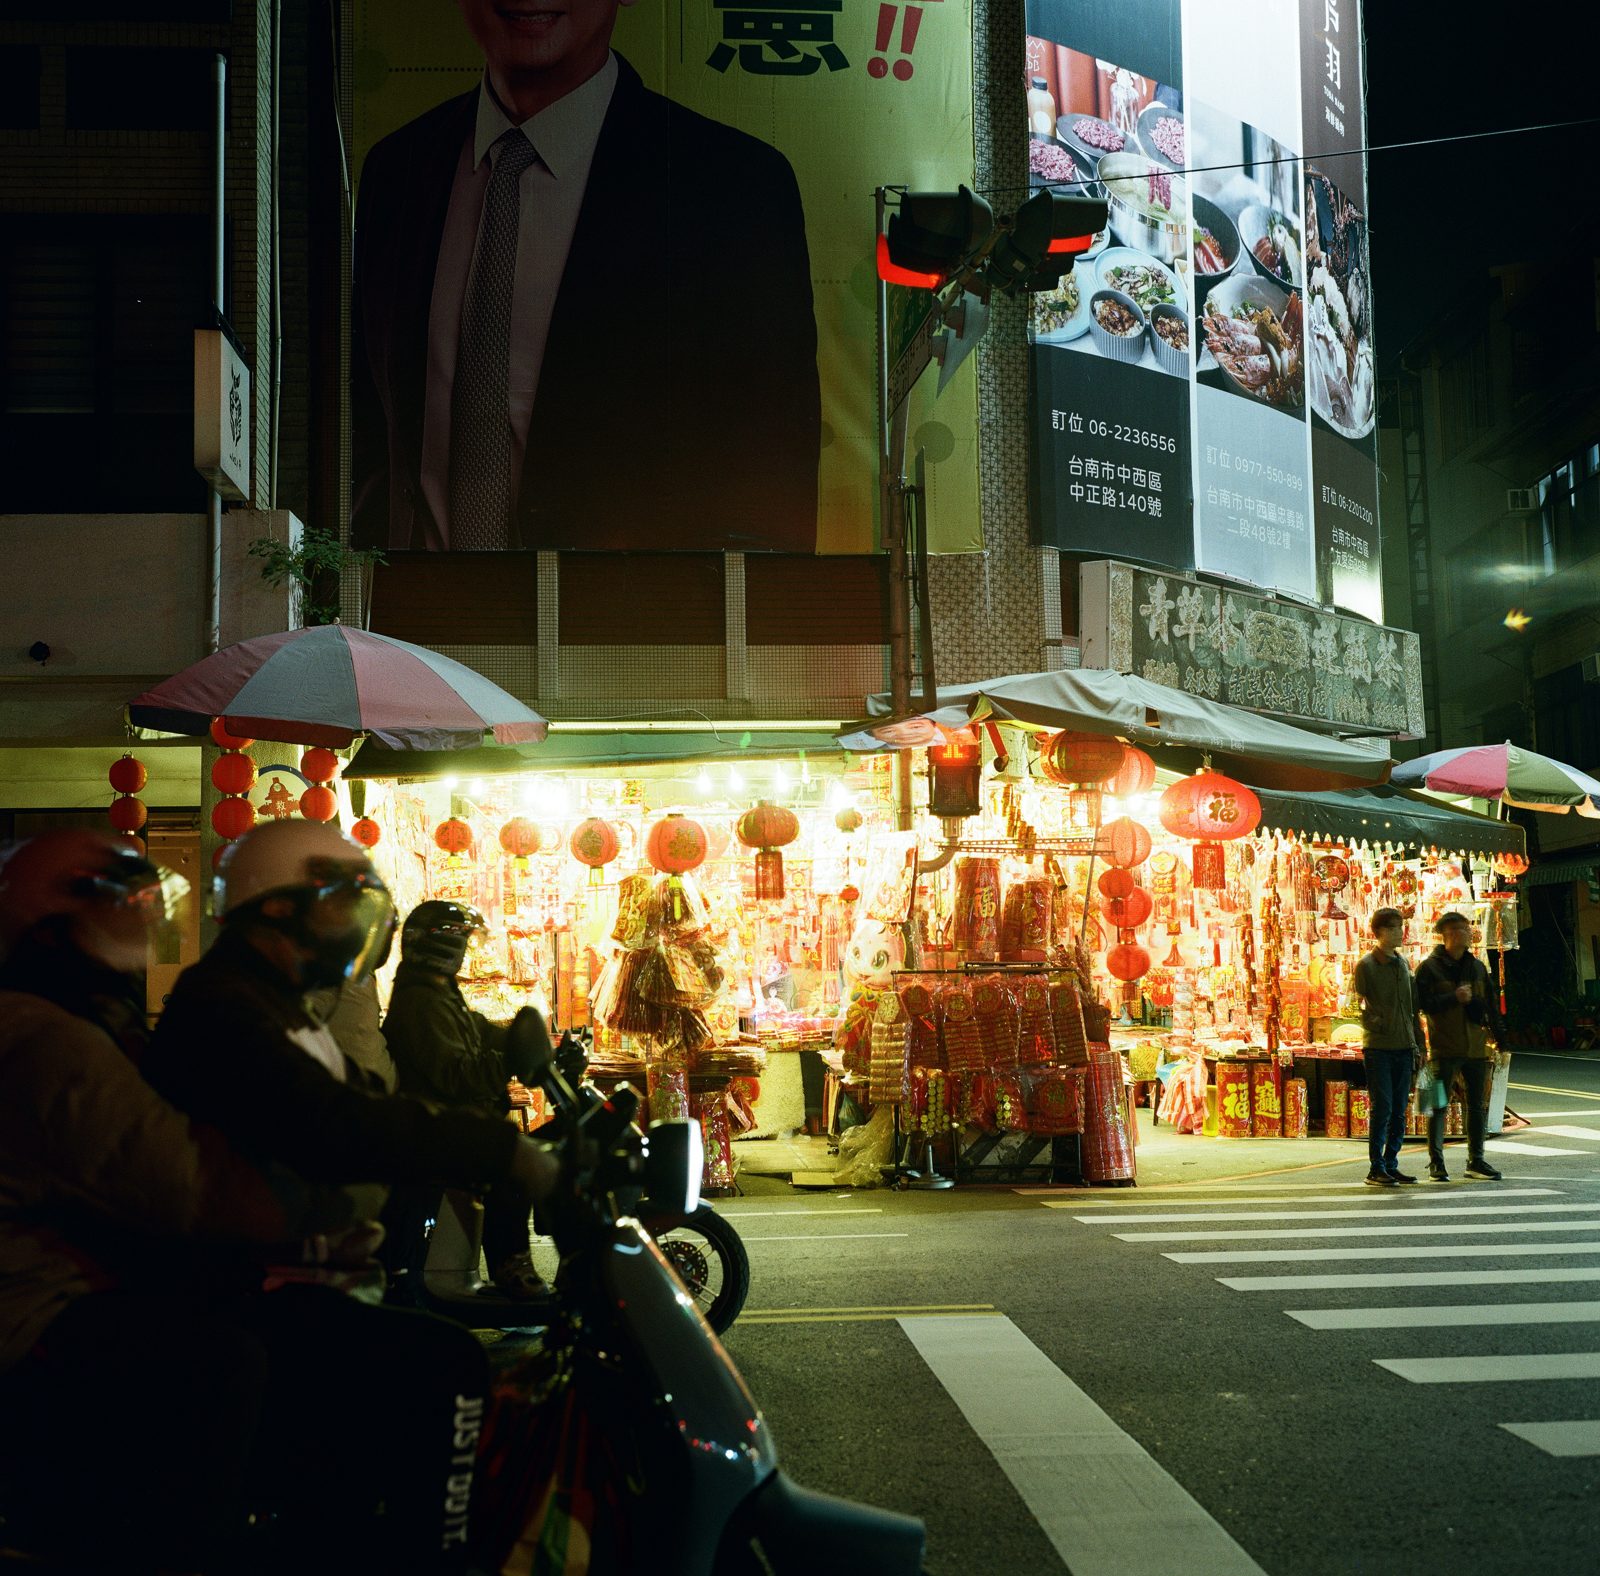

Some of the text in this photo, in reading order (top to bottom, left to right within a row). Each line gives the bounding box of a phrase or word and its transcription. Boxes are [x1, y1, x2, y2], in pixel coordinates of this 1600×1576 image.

[1052, 409, 1176, 454] 訂位 06-2236556
[1068, 455, 1163, 493] 台南市中西區
[1206, 444, 1303, 492] 訂位 0977-550-899
[1069, 482, 1162, 518] 中正路140號
[1207, 485, 1305, 531] 台南市中西區忠義路
[1321, 484, 1337, 506] 訂位
[1208, 791, 1240, 824] 福
[1223, 1082, 1251, 1119] 福
[451, 1394, 483, 1466] JUST
